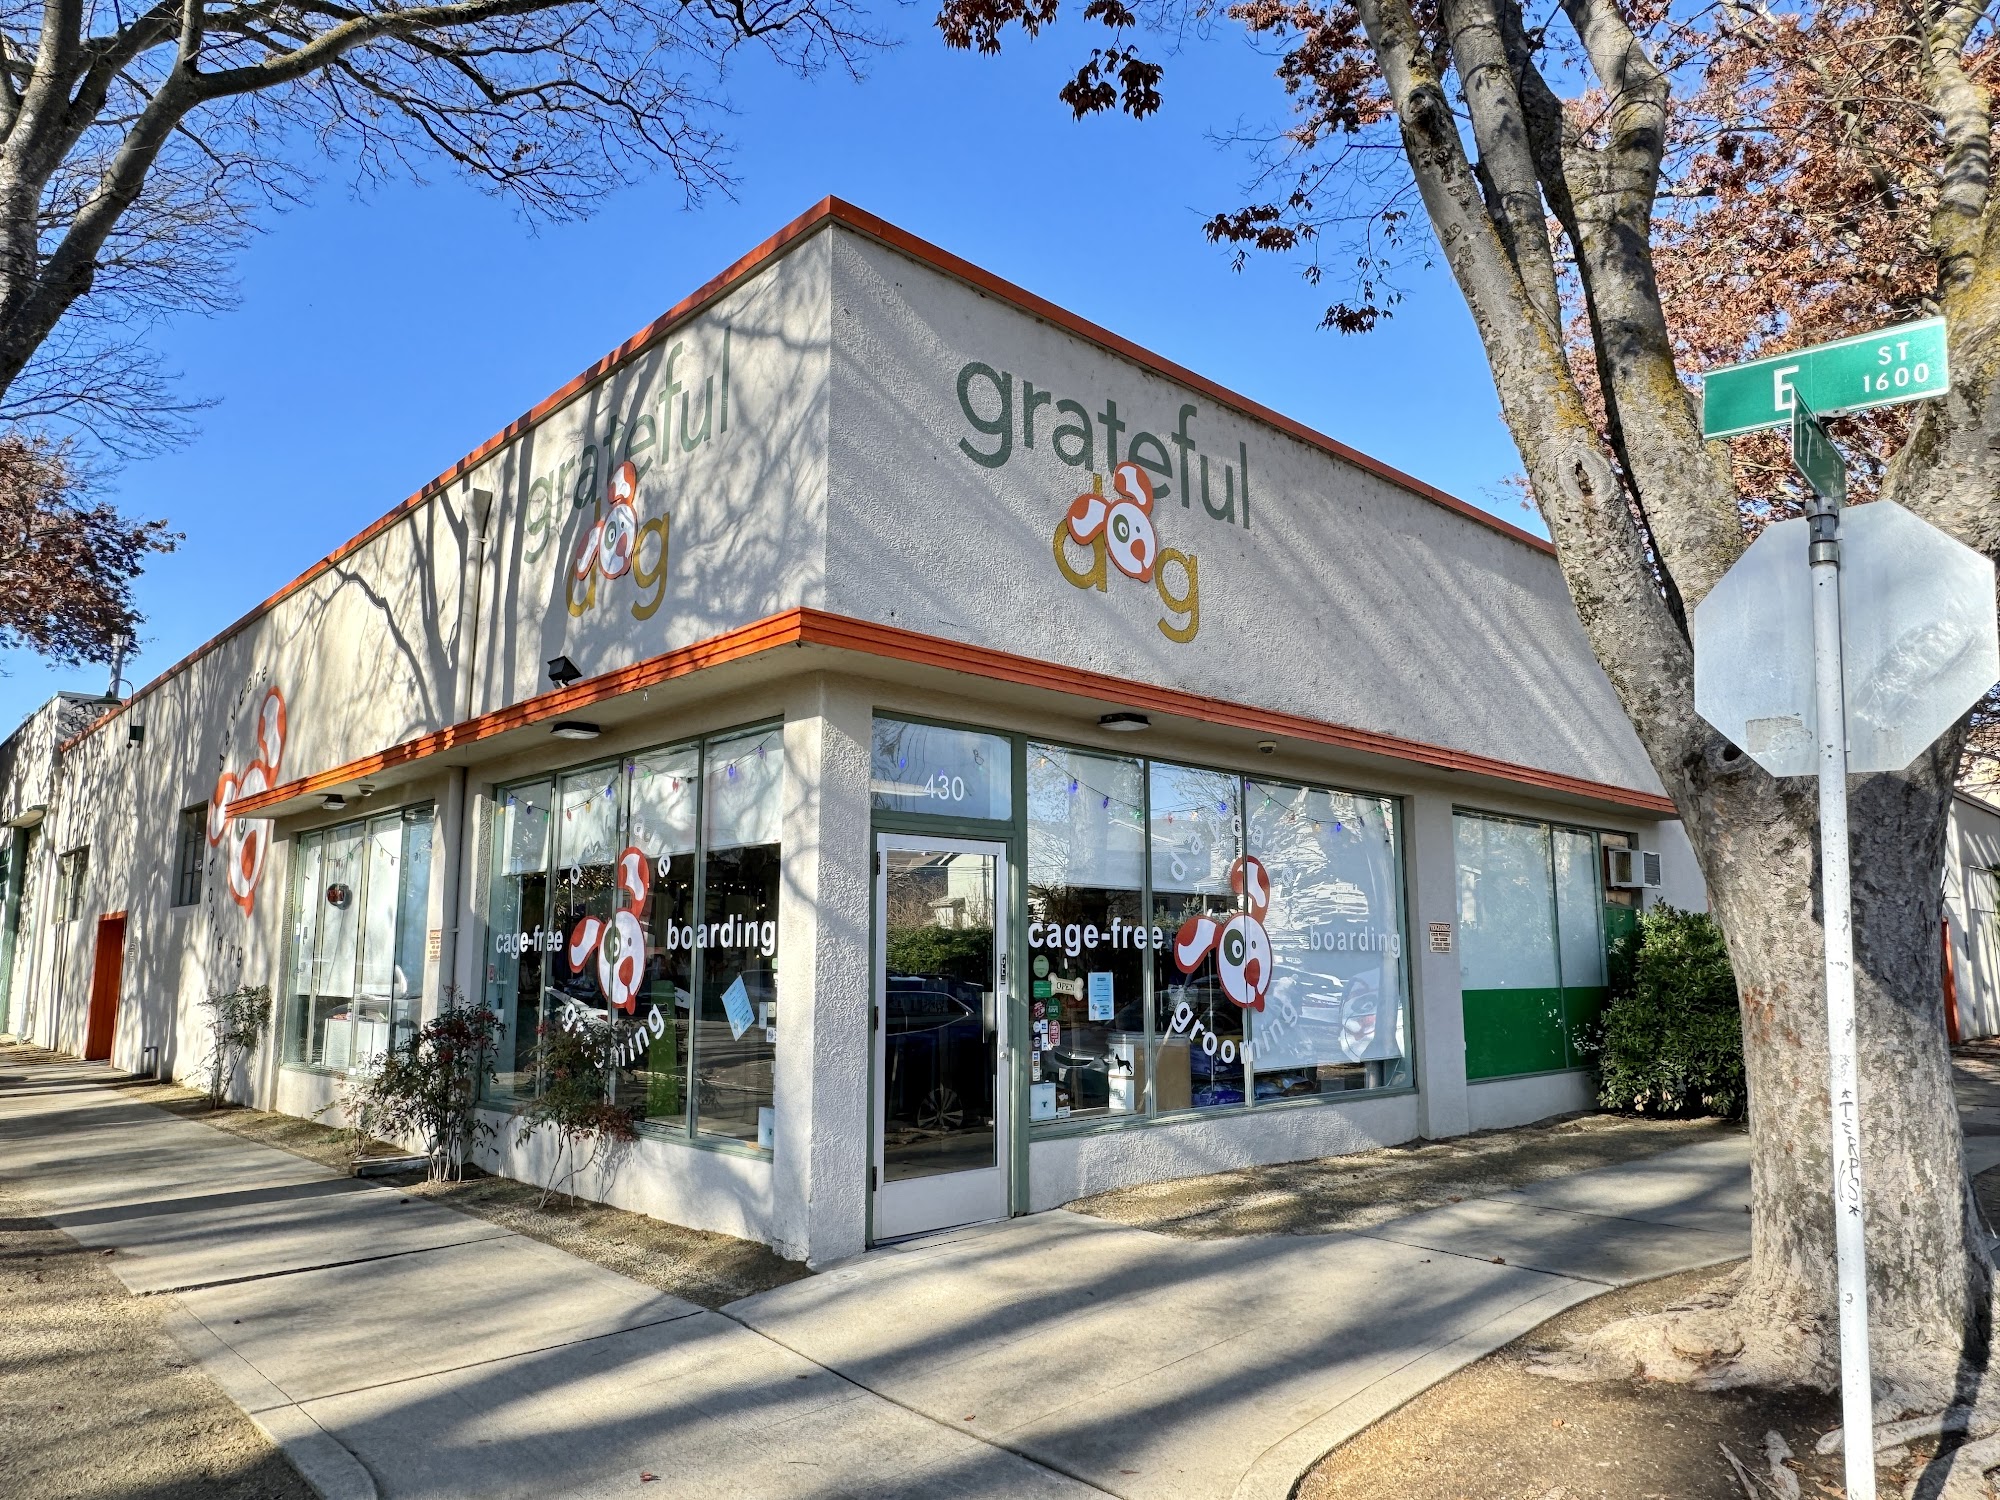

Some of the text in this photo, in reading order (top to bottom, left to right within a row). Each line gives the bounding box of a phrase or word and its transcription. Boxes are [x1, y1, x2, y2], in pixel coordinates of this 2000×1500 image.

[1773, 341, 1910, 412] E ST
[1863, 363, 1930, 393] 1600
[523, 325, 731, 564] grateful
[956, 361, 1250, 530] grateful
[219, 665, 267, 772] daycare
[923, 774, 965, 801] 430
[1170, 814, 1294, 889] daycae
[496, 924, 563, 959] cage-free
[667, 914, 776, 957] boarding
[1028, 917, 1163, 957] cage-free
[1310, 924, 1401, 959] boarding
[1056, 982, 1075, 991] OPEN
[1171, 1002, 1298, 1064] grooming
